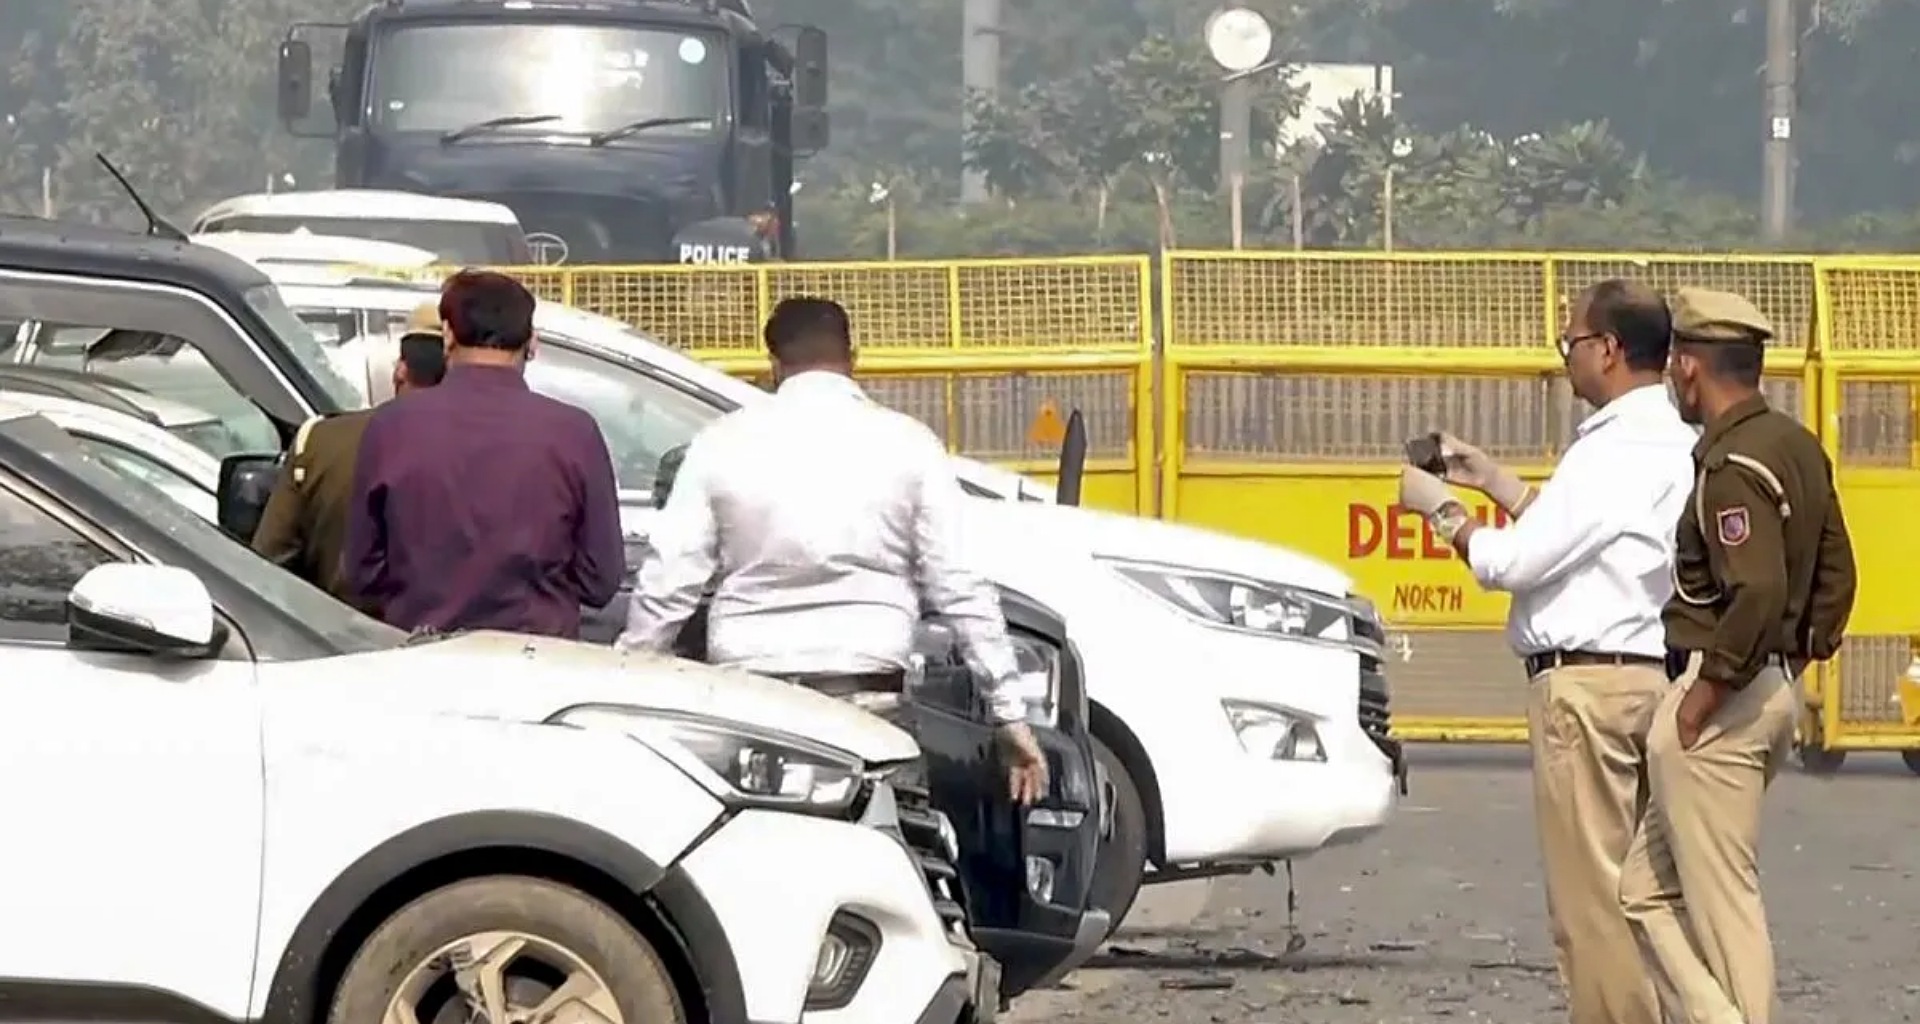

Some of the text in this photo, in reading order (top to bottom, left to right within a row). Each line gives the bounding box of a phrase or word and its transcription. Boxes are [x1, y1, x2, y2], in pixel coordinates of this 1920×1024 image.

[680, 243, 750, 264] POLICE
[1348, 503, 1507, 559] DEL
[1393, 585, 1462, 611] NORTH
